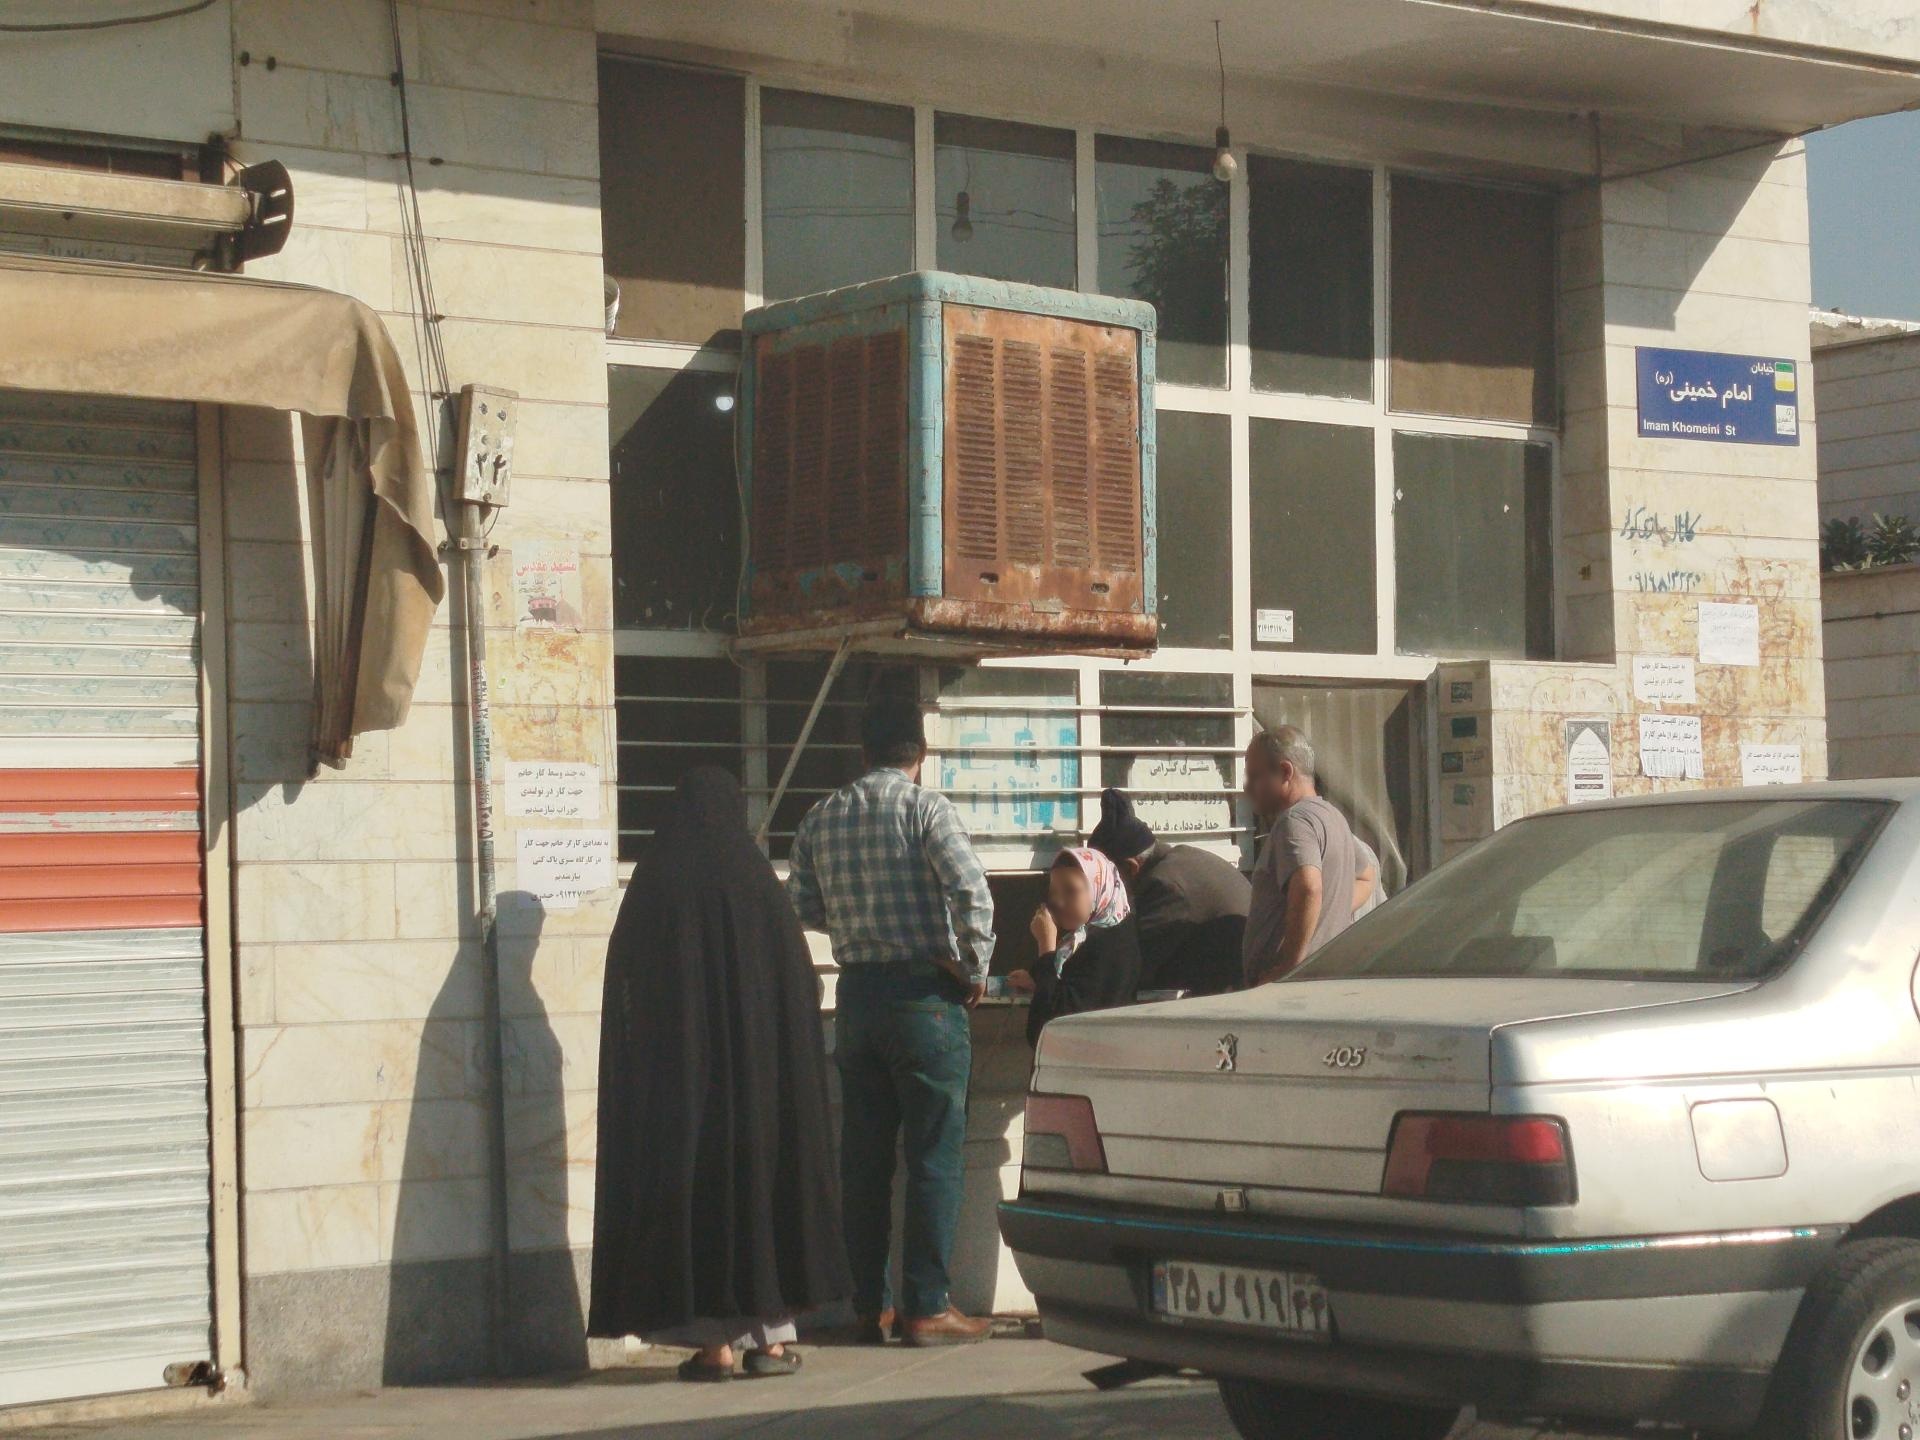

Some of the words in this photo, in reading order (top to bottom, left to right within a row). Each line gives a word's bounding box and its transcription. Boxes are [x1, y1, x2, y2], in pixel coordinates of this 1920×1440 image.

[1751, 362, 1774, 375] خیابان
[1655, 371, 1674, 385] (ره)
[1671, 381, 1717, 401] خمینی
[1722, 384, 1752, 408] امام
[1643, 419, 1670, 432] Imam
[1672, 421, 1720, 434] Khomeini
[1725, 425, 1737, 436] St
[1150, 759, 1178, 776] گرامی
[1180, 757, 1210, 776] مشتری
[518, 768, 533, 778] خانم
[536, 768, 545, 779] کار
[548, 768, 563, 778] وسط
[520, 787, 544, 797] تولیدی
[546, 788, 553, 797] در
[556, 787, 565, 797] کار
[567, 788, 583, 796] جهت
[525, 804, 555, 815] نیازمندیم
[556, 805, 578, 815] جوراب
[524, 839, 534, 848] کار
[555, 872, 581, 882] نیازمندیم
[1323, 1047, 1364, 1067] 405
